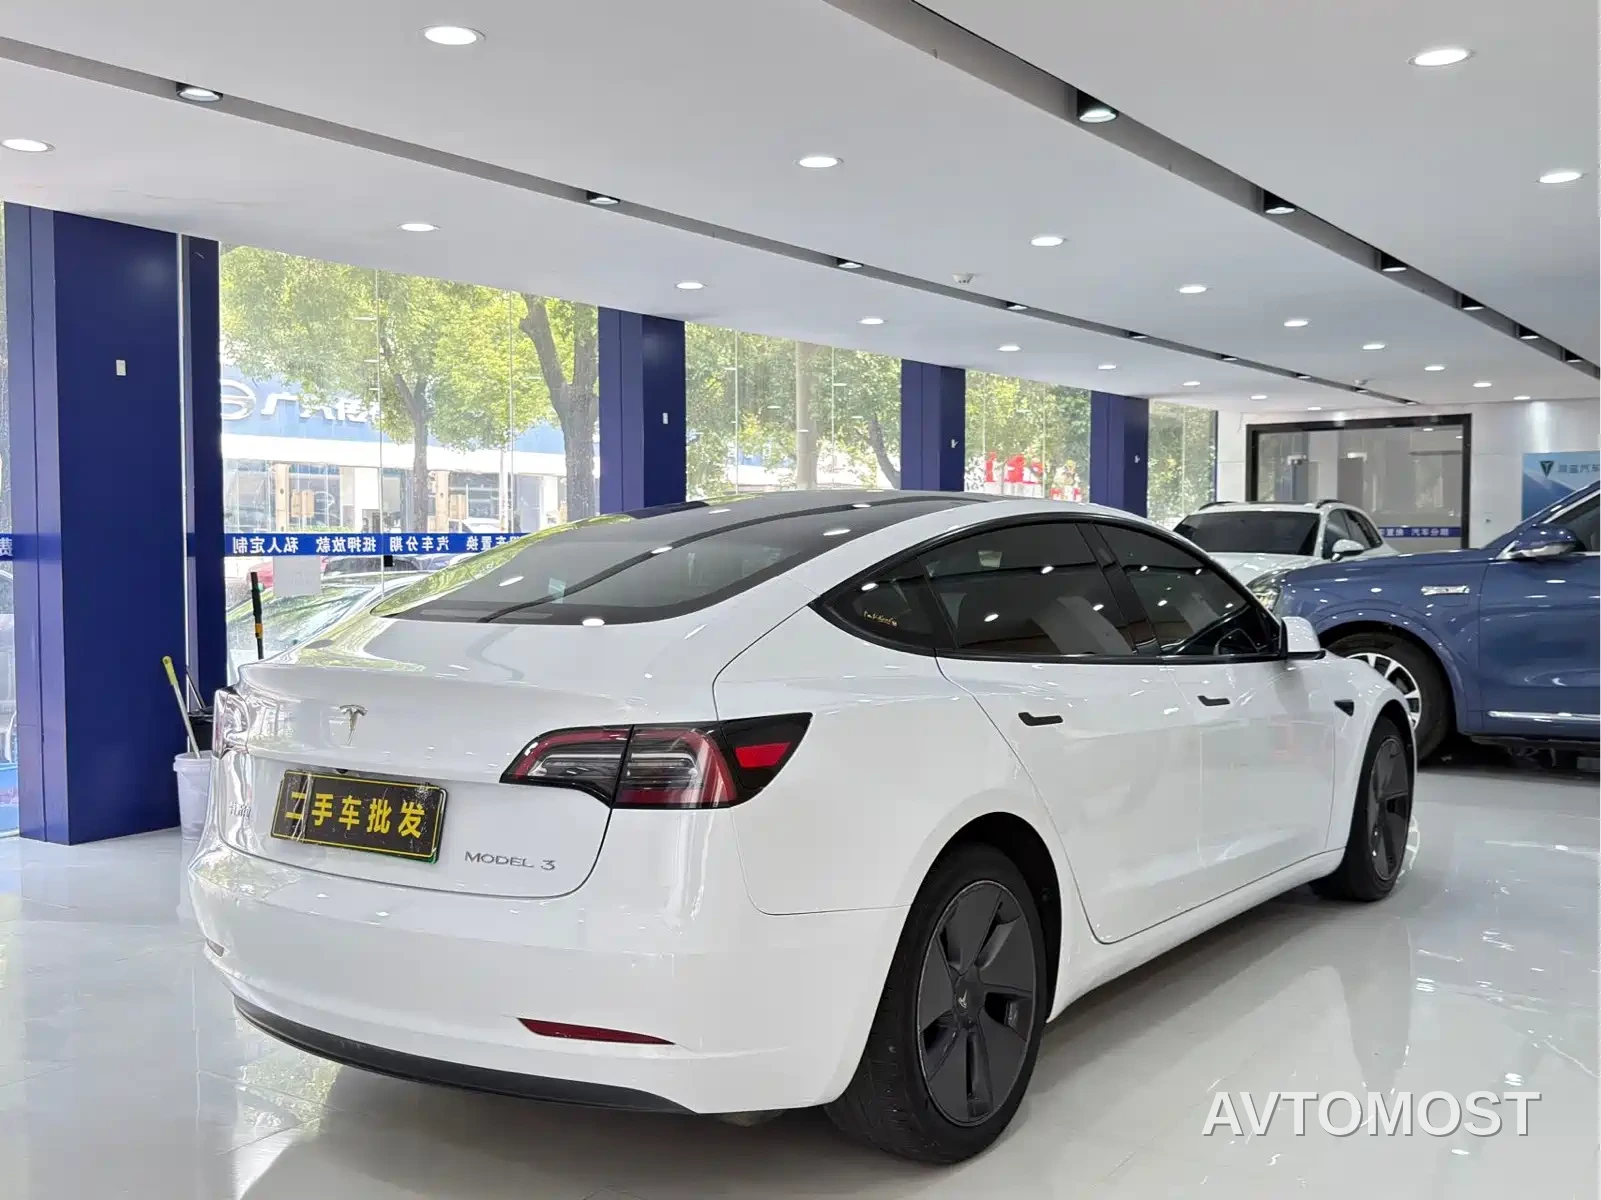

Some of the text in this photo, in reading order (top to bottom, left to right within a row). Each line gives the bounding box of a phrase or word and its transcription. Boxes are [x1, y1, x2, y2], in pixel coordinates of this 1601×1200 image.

[284, 791, 426, 839] 二手车批发
[464, 851, 557, 871] MODEL 3
